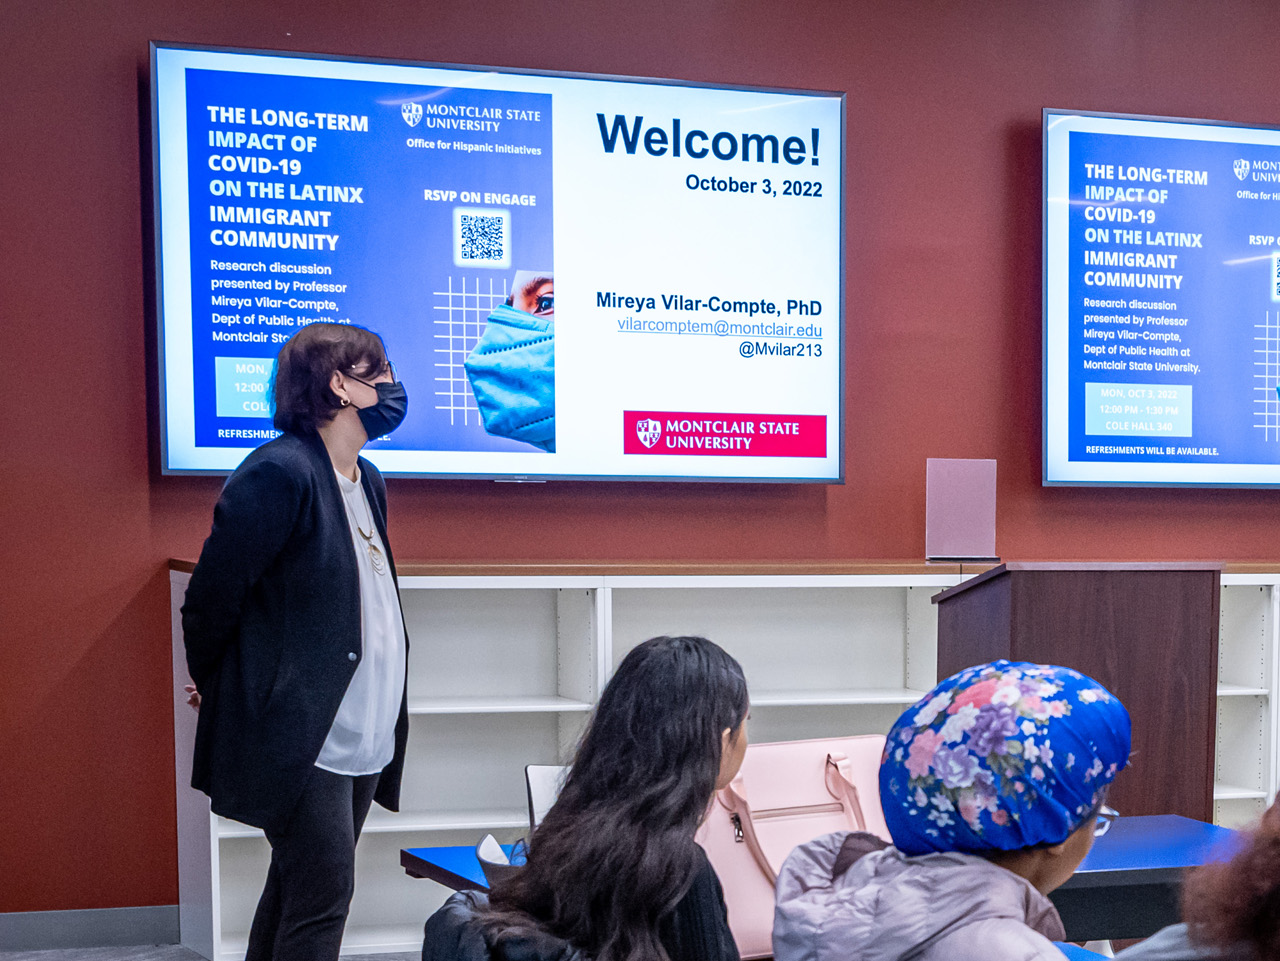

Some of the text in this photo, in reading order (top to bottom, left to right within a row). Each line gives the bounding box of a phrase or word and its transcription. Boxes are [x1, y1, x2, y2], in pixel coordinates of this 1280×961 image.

[207, 106, 368, 132] THE LONG-TERM
[427, 104, 541, 121] MONTCLAIR STATE
[427, 118, 500, 132] UNIVERSITY
[208, 131, 317, 152] IMPACT OF
[406, 138, 542, 155] Office for Hispanic Initiatives
[596, 113, 820, 166] Welcome!
[208, 155, 301, 175] COVID-19
[1085, 164, 1208, 185] THE LONG-TERM
[209, 180, 363, 203] ON THE LATINX
[686, 174, 822, 197] October 3, 2022
[424, 189, 536, 206] RSVP ON ENGAGE
[1085, 185, 1168, 204] IMPACT OF
[1237, 190, 1257, 200] Office
[1259, 191, 1270, 201] for
[210, 206, 331, 227] IMMIGRANT
[1084, 206, 1155, 223] COVID-19
[210, 229, 339, 251] COMMUNITY
[1084, 228, 1202, 247] ON THE LATINX
[1249, 235, 1274, 247] RSVP
[210, 260, 331, 275] Research discussion
[1084, 251, 1177, 268] IMMIGRANT
[211, 278, 347, 294] presented by Professor
[1084, 271, 1183, 289] COMMUNITY
[212, 296, 339, 312] Mireya Vilar-Compte,
[596, 292, 822, 317] Mireya Vilar-Compte, PhD
[1084, 298, 1177, 311] Research discussion
[212, 313, 240, 326] Dept
[242, 314, 255, 325] of
[258, 314, 294, 326] Public
[617, 317, 822, 338] vilarcomptem@montclair.edu
[1084, 314, 1188, 327] presented by Professor
[212, 331, 269, 343] Montclair
[1084, 329, 1182, 343] Mireya Vilar-Compte,
[739, 341, 822, 358] @Mvilar213
[1084, 345, 1190, 357] Dept of Public Health at
[236, 364, 268, 375] MON,
[1084, 360, 1201, 375] Montclair State University.
[235, 383, 264, 392] 12:00
[1101, 389, 1177, 399] MON, OCT 3, 2022
[1100, 405, 1122, 414] 12:00
[1125, 406, 1138, 414] PM
[1165, 407, 1178, 415] PM
[218, 429, 281, 438] REFRESHMEN
[666, 420, 799, 435] MONTCLAIR STATE
[1106, 422, 1172, 431] COLE HALL 340
[666, 436, 752, 449] UNIVERSITY
[1086, 446, 1144, 454] REFRESHMENTS
[1177, 448, 1219, 456] AVAILABLE.
